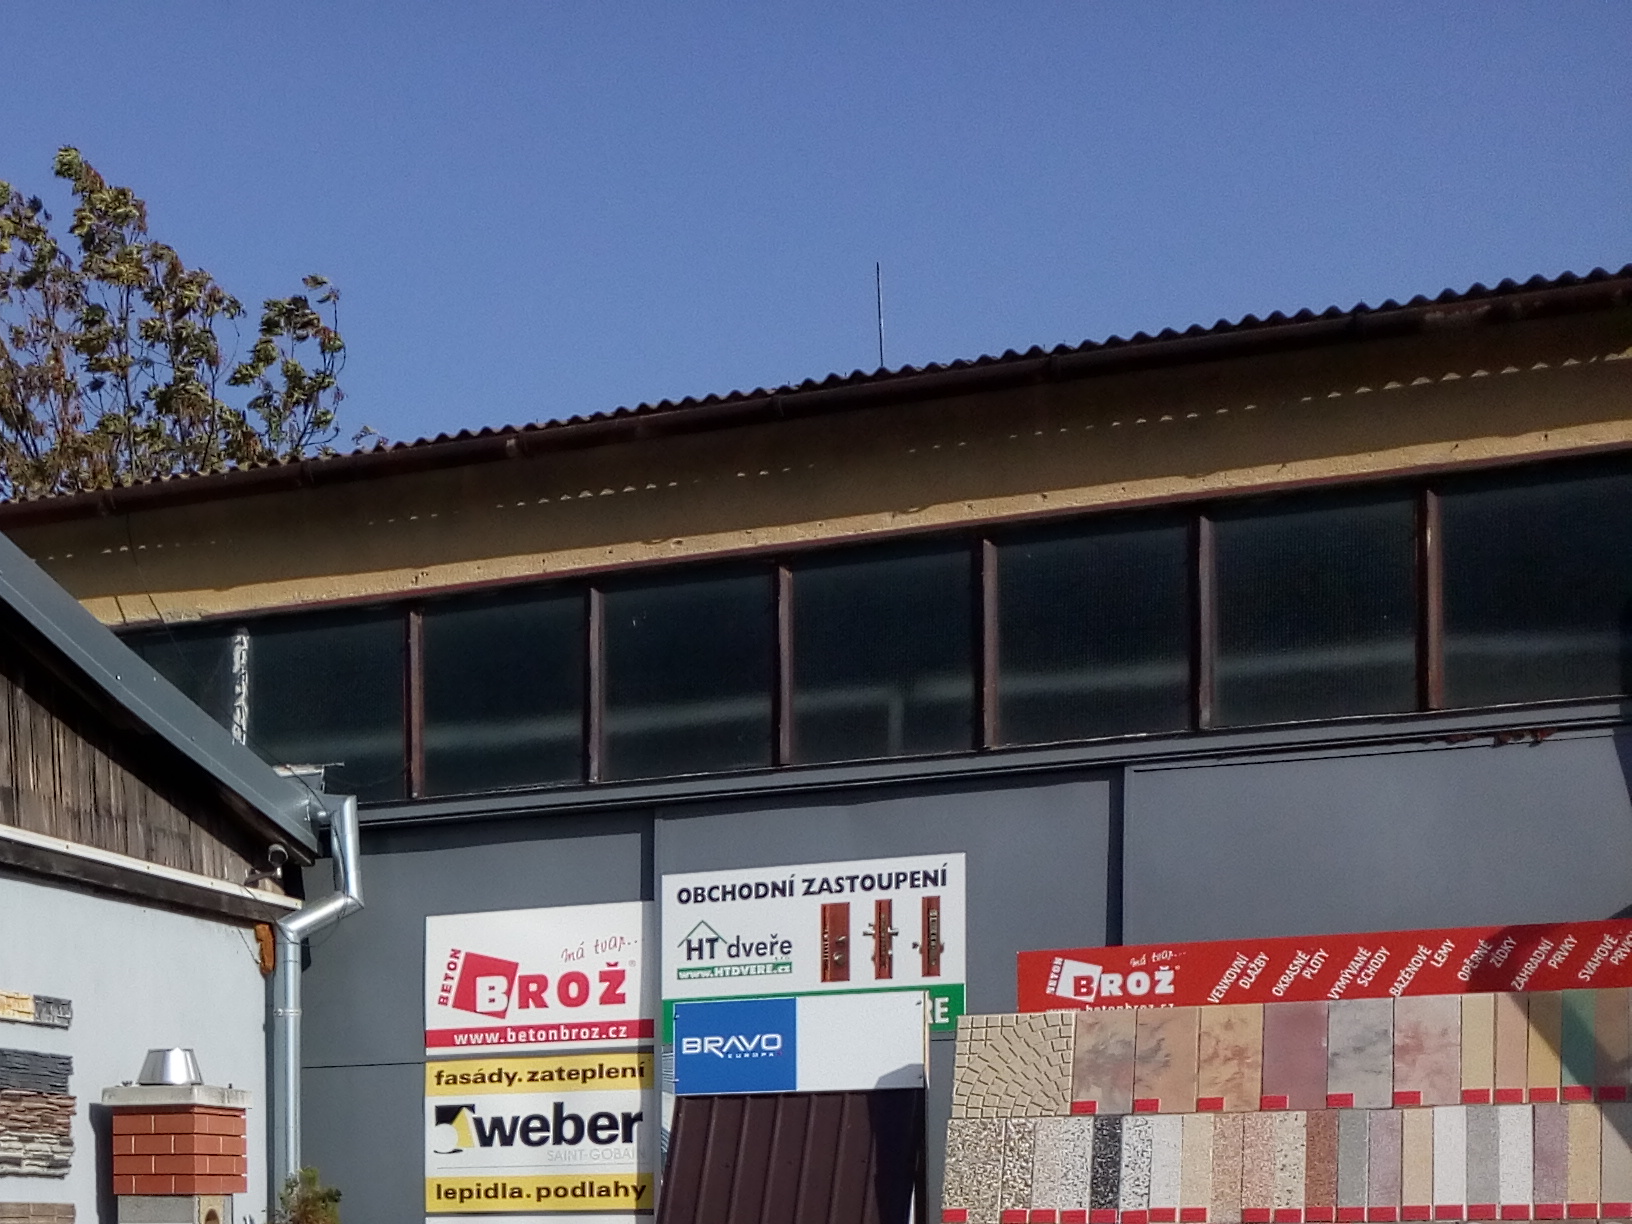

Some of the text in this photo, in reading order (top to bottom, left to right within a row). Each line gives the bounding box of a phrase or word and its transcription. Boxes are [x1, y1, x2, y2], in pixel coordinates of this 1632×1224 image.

[677, 863, 948, 904] OBCHODNÍ ZASTOUPENÍ
[561, 941, 585, 963] má
[686, 933, 793, 961] HT dveře
[1302, 948, 1330, 980] PLOTY
[1430, 939, 1456, 968] LEMY
[1489, 936, 1517, 969] ZÍDKY
[1511, 937, 1555, 991] ZAHRADNÍ
[1548, 934, 1578, 970] PRVKY
[1578, 933, 1619, 982] SVAHOVÉ
[438, 948, 462, 1006] BETON
[678, 963, 792, 980] www.HTDVERE.cz
[1073, 965, 1175, 997] BROŽ
[1207, 952, 1250, 1004] VENKOVNÍ
[1238, 952, 1270, 990] DLAŽBY
[1271, 950, 1311, 997] OKRASNÉ
[1357, 946, 1391, 987] SCHODY
[1388, 944, 1433, 998] BAZÉNOVÉ
[476, 961, 626, 1013] BROŽ
[454, 1024, 629, 1046] www.betonbroz.cz
[682, 1034, 782, 1058] BRAVO
[473, 1101, 644, 1148] weber
